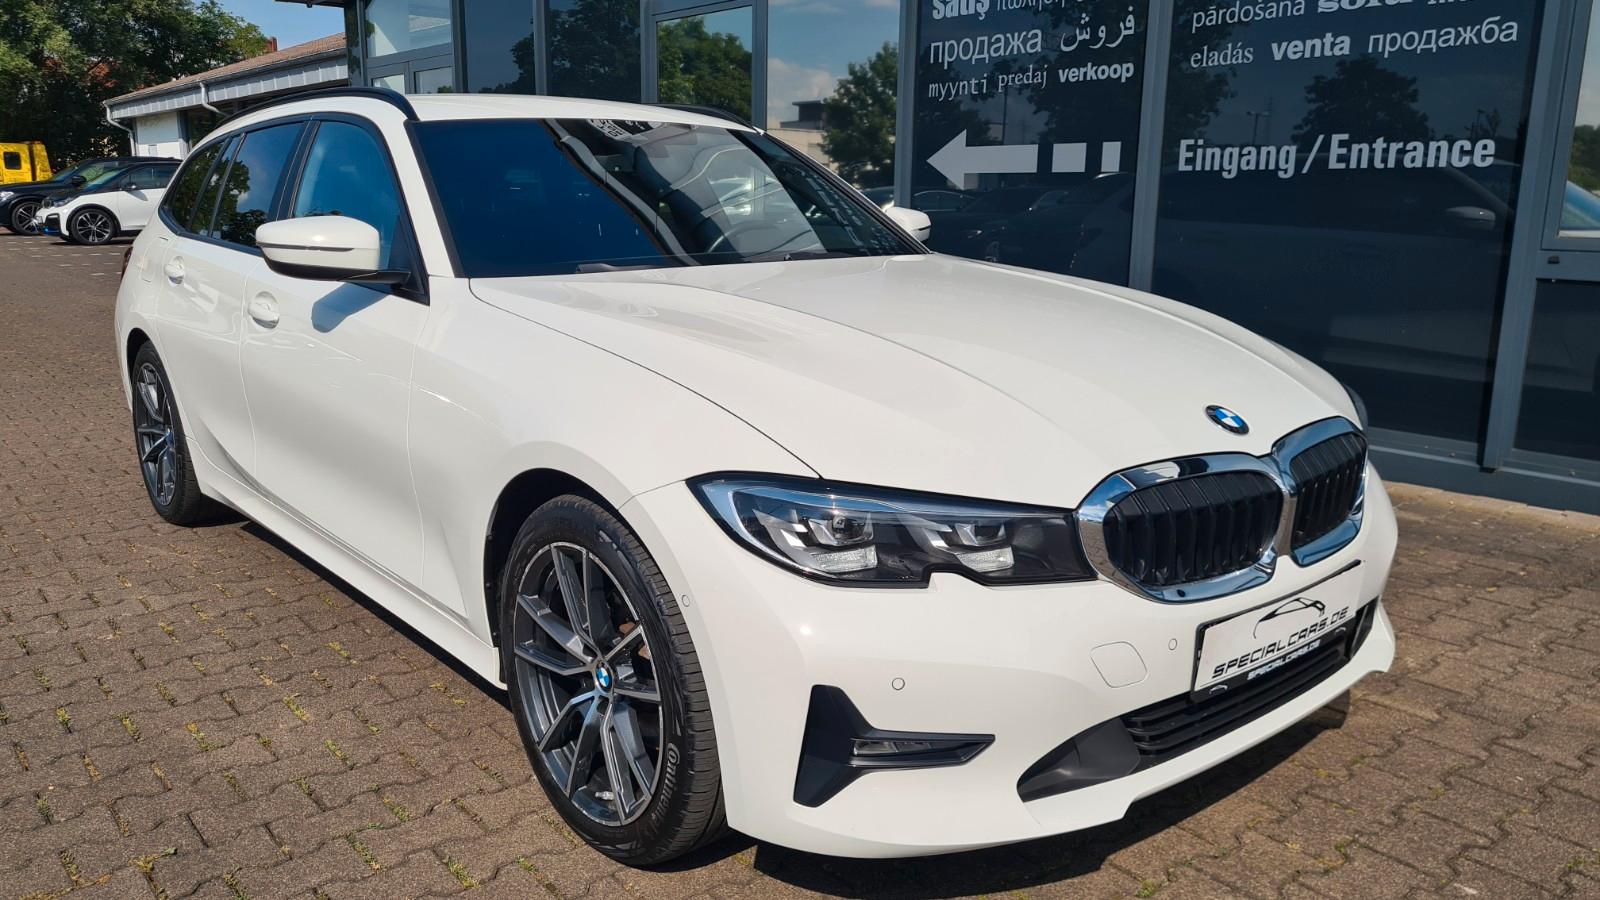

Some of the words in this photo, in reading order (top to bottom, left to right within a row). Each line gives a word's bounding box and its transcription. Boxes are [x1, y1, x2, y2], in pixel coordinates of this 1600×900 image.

[1060, 6, 1135, 51] فروش
[1368, 16, 1519, 58] продажба
[930, 29, 1042, 69] продажа
[1190, 42, 1254, 68] eladás
[1271, 32, 1351, 61] venta
[928, 74, 988, 101] myynti
[998, 65, 1048, 92] predaj
[1058, 62, 1135, 83] verkoop
[1177, 138, 1297, 180] Eingang
[1328, 133, 1496, 170] Entrance
[1211, 606, 1349, 679] SPECIALCARS.DE
